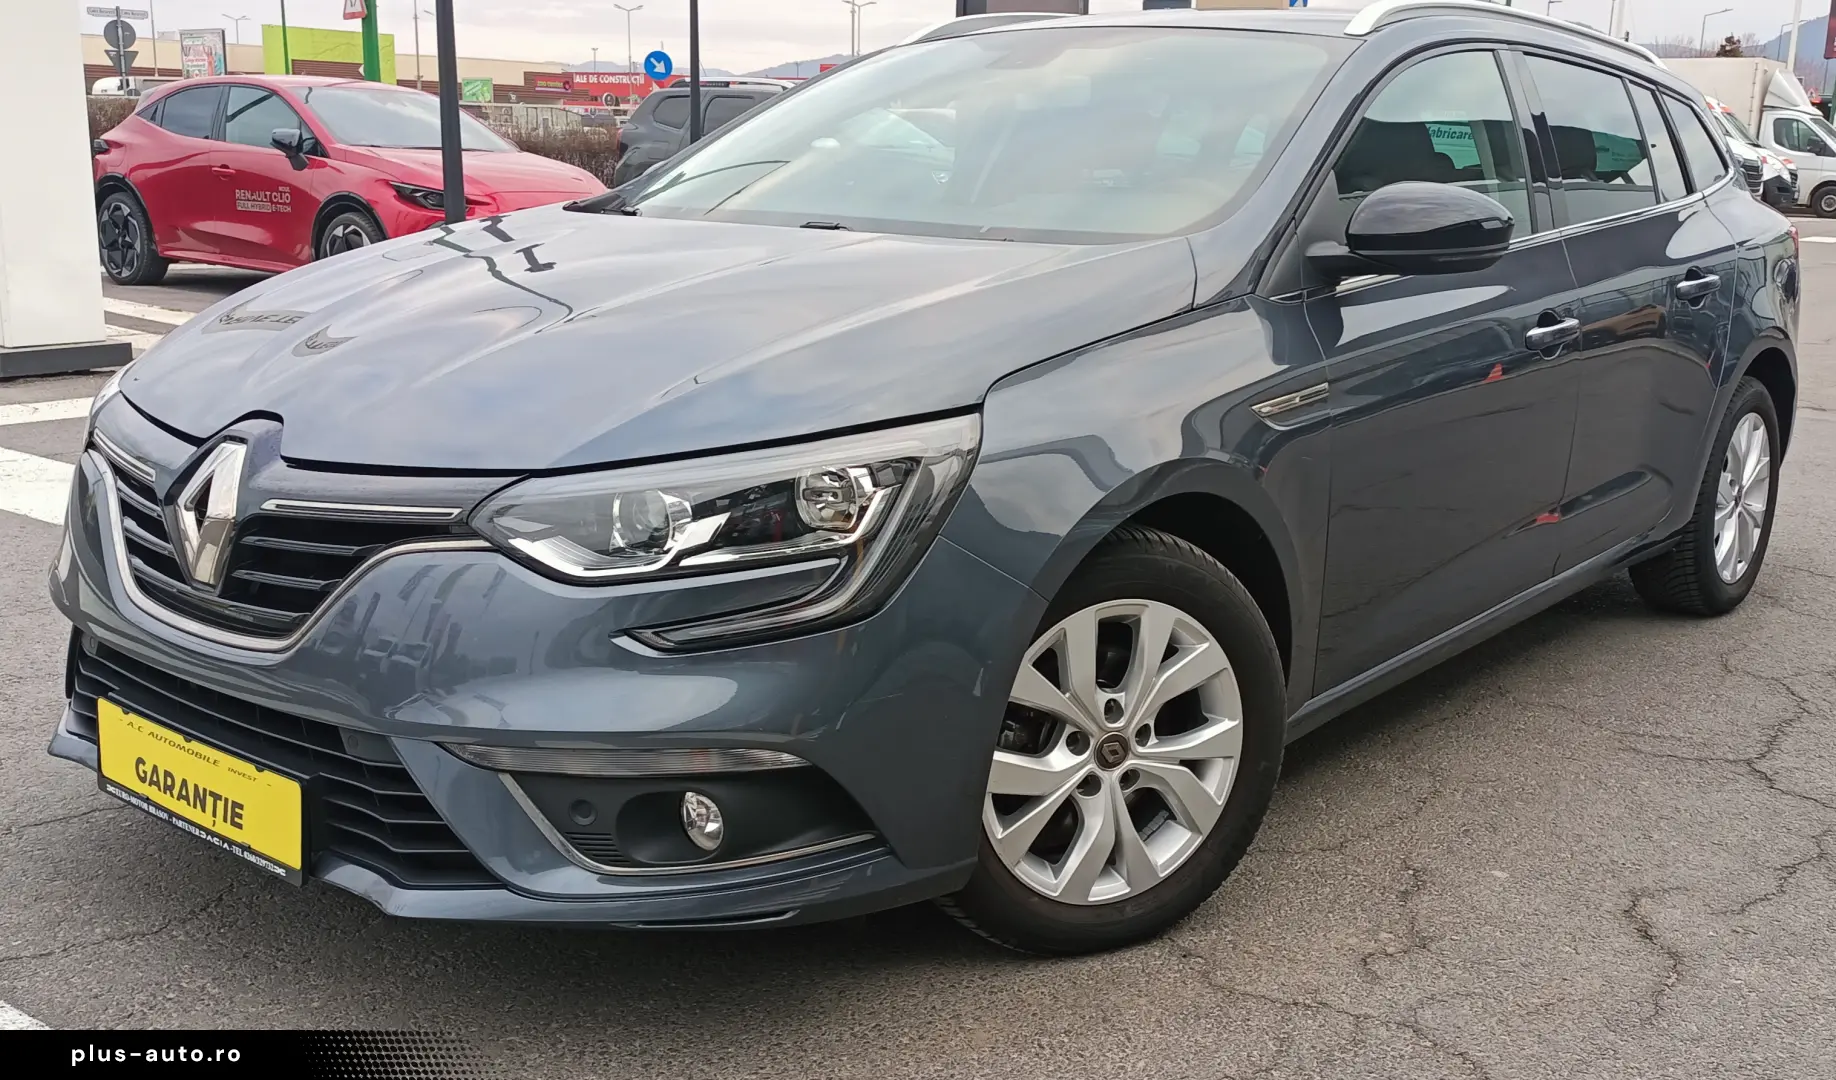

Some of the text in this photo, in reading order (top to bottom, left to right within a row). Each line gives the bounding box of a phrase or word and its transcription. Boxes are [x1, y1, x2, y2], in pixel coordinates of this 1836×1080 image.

[589, 74, 598, 84] DE
[235, 189, 291, 203] RENAULT CLIO
[237, 202, 292, 213] FULL HYBRID E-TECH
[148, 731, 220, 767] AUTOMOBILE
[227, 766, 258, 783] INVEST
[135, 756, 244, 830] GARANȚIE
[172, 816, 200, 837] PARTENER
